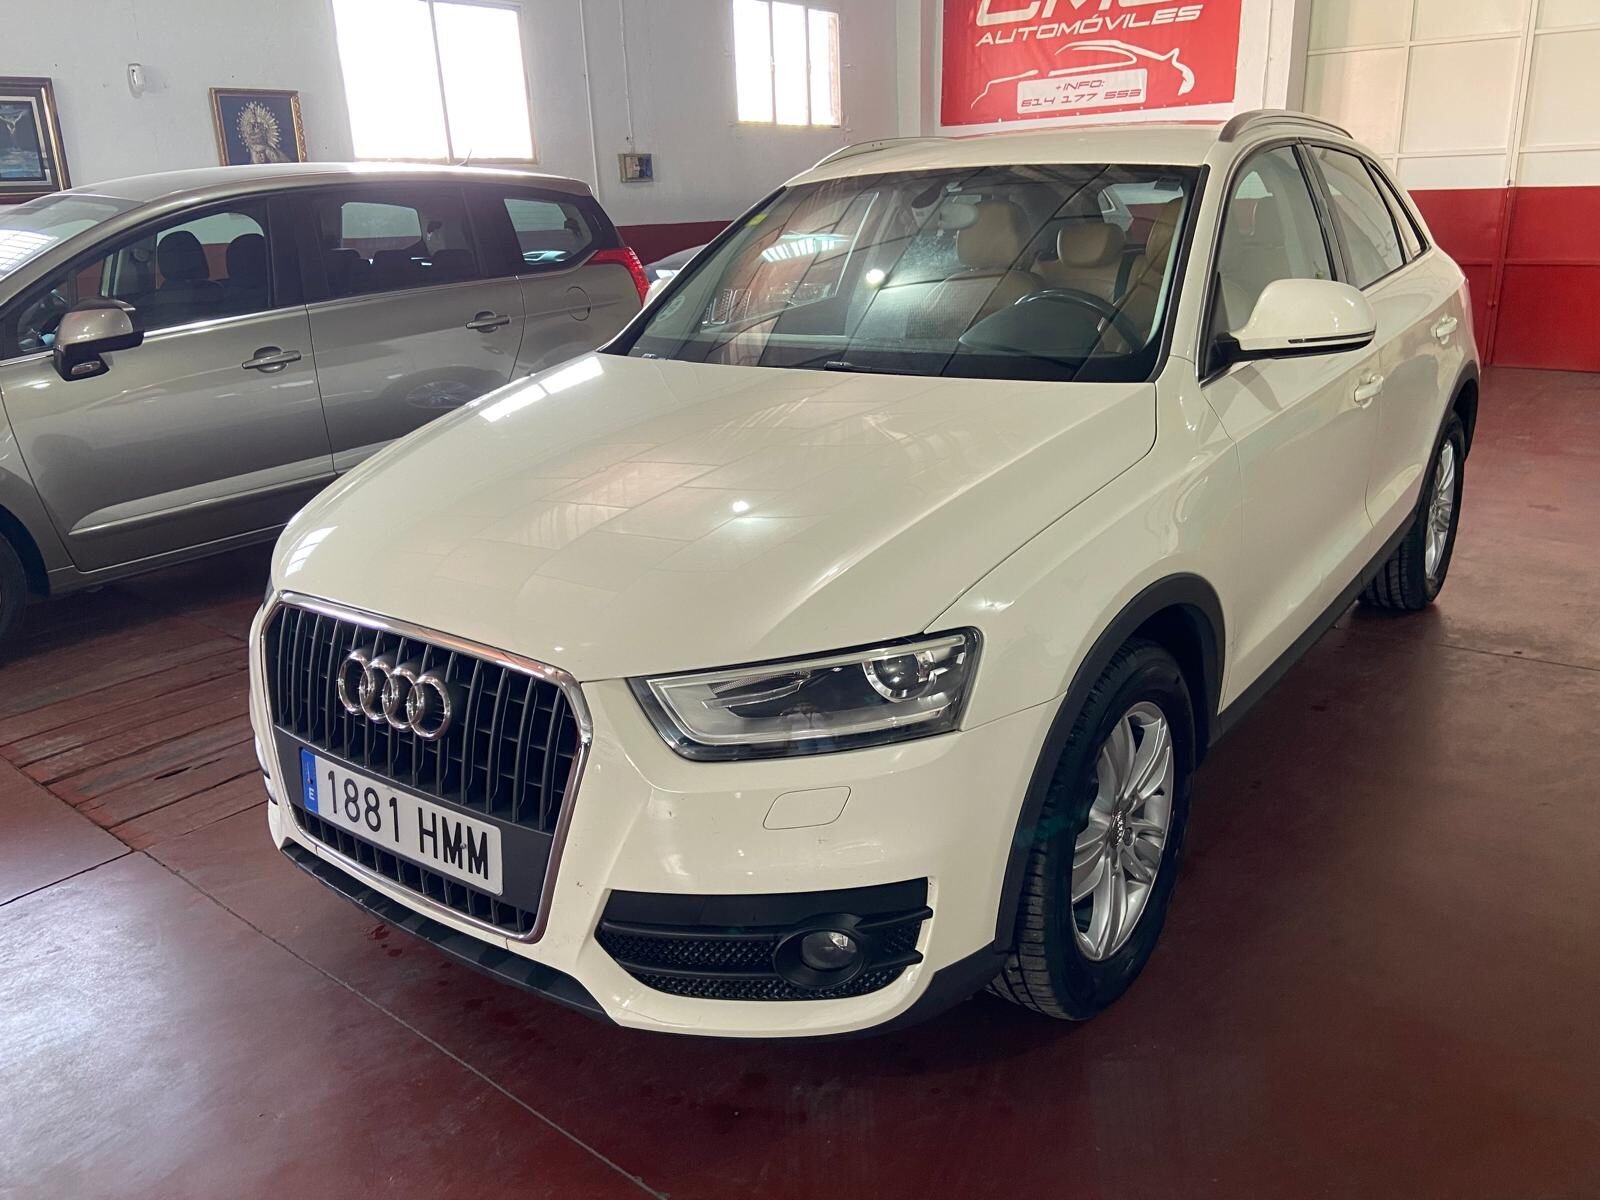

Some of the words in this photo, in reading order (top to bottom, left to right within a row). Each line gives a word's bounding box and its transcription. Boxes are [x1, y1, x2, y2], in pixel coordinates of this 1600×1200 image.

[976, 4, 1204, 47] AUTOMÓVILES
[1061, 92, 1098, 104] 177
[327, 769, 400, 843] 1881
[417, 806, 489, 881] HMM
